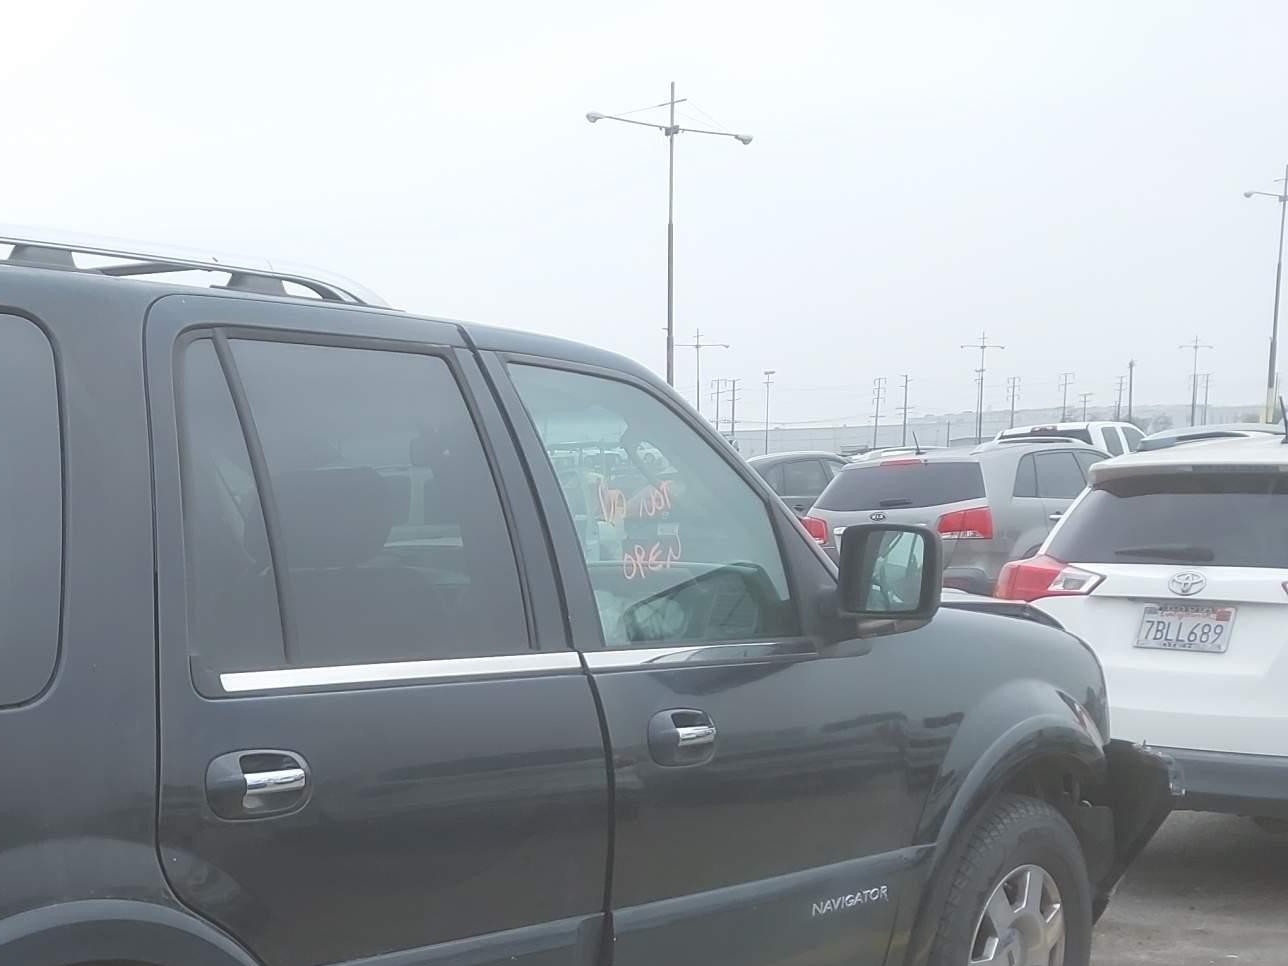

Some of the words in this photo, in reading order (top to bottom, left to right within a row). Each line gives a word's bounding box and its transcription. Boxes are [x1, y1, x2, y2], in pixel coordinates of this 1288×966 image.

[638, 479, 672, 518] NOT
[623, 534, 682, 580] OPEN
[1144, 619, 1224, 645] 7BLL689
[811, 884, 889, 917] NAVIGATOR
